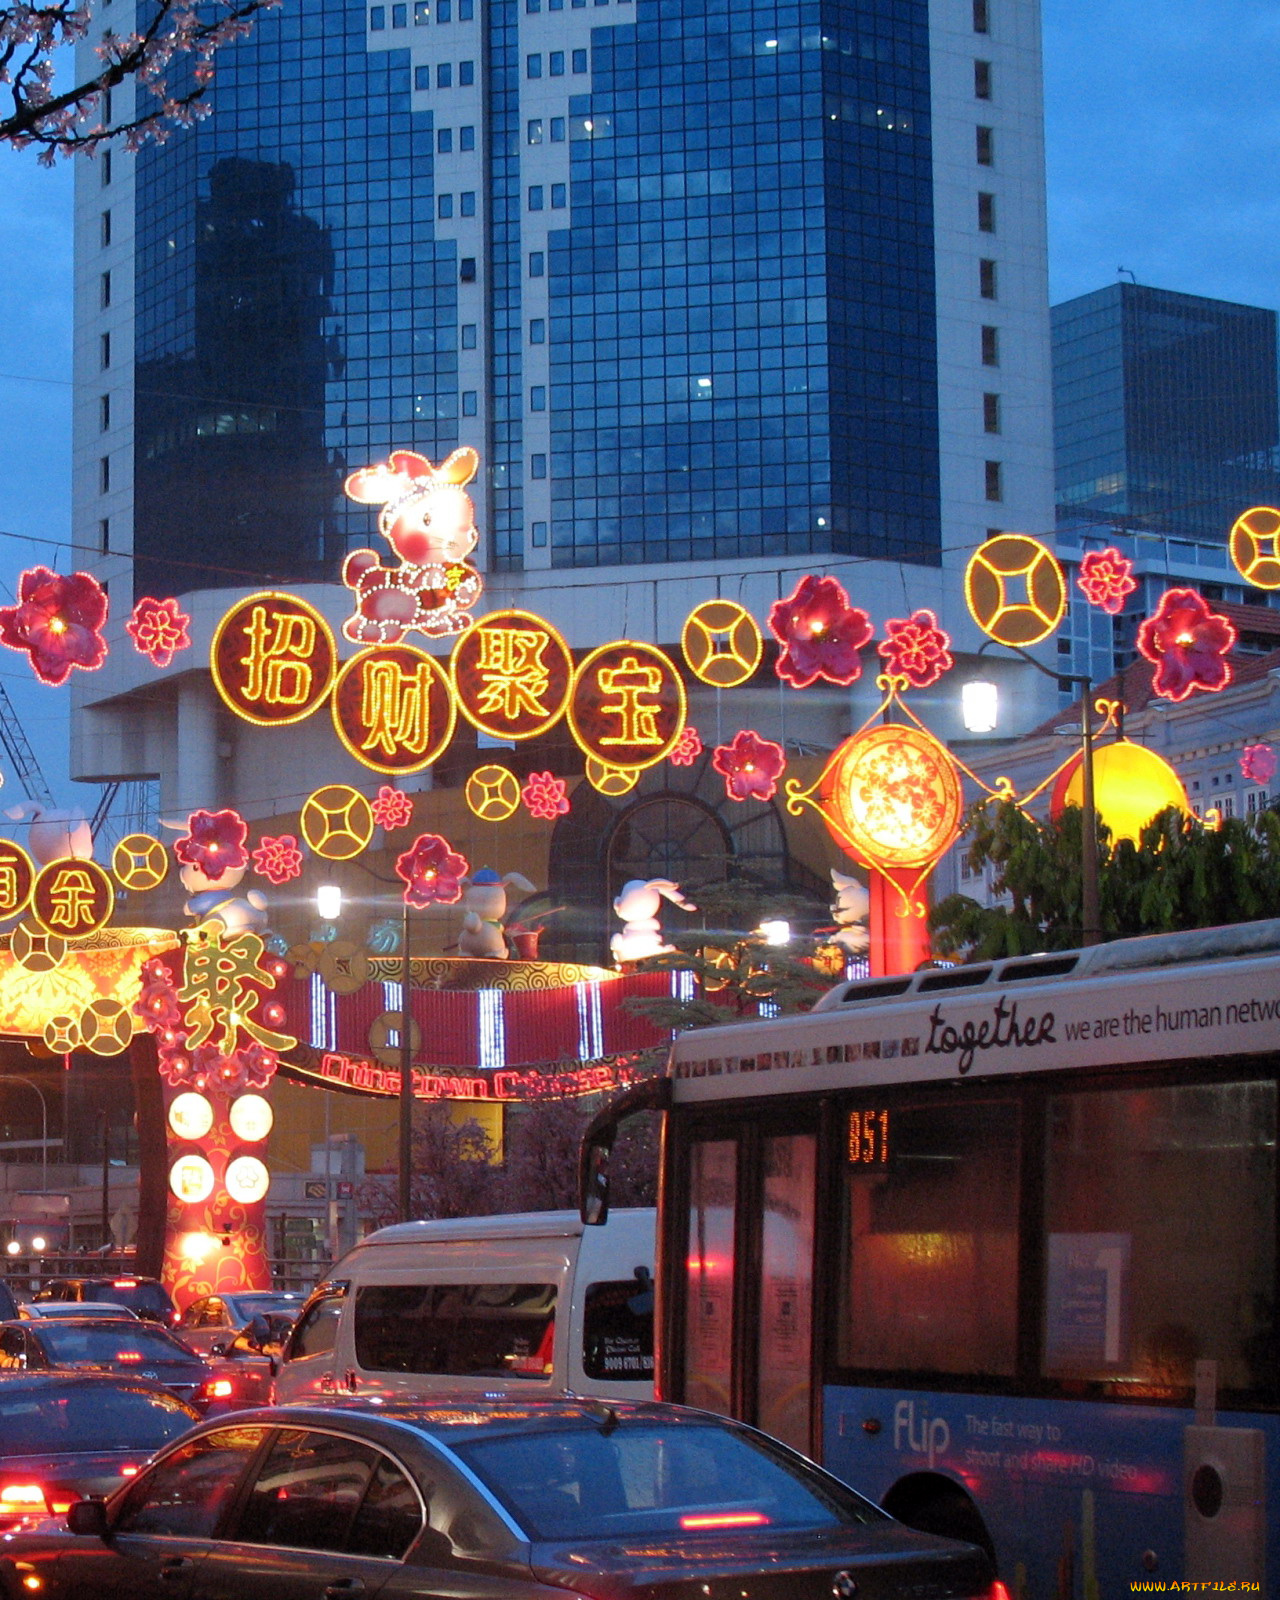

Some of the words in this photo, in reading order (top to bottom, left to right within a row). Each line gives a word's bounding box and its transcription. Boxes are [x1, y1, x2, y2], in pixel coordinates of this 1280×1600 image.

[241, 606, 664, 756] 招财聚宝
[925, 995, 1057, 1075] together
[1065, 1021, 1090, 1042] we
[1093, 1016, 1120, 1038] are
[1123, 1008, 1151, 1035] the
[1156, 1005, 1221, 1032] human
[322, 1053, 488, 1098] Chinatown
[965, 1414, 988, 1436] The
[991, 1416, 1015, 1437] fast
[1018, 1424, 1044, 1445] way
[1046, 1423, 1062, 1441] to
[1070, 1455, 1095, 1476] HD
[1098, 1459, 1138, 1479] video
